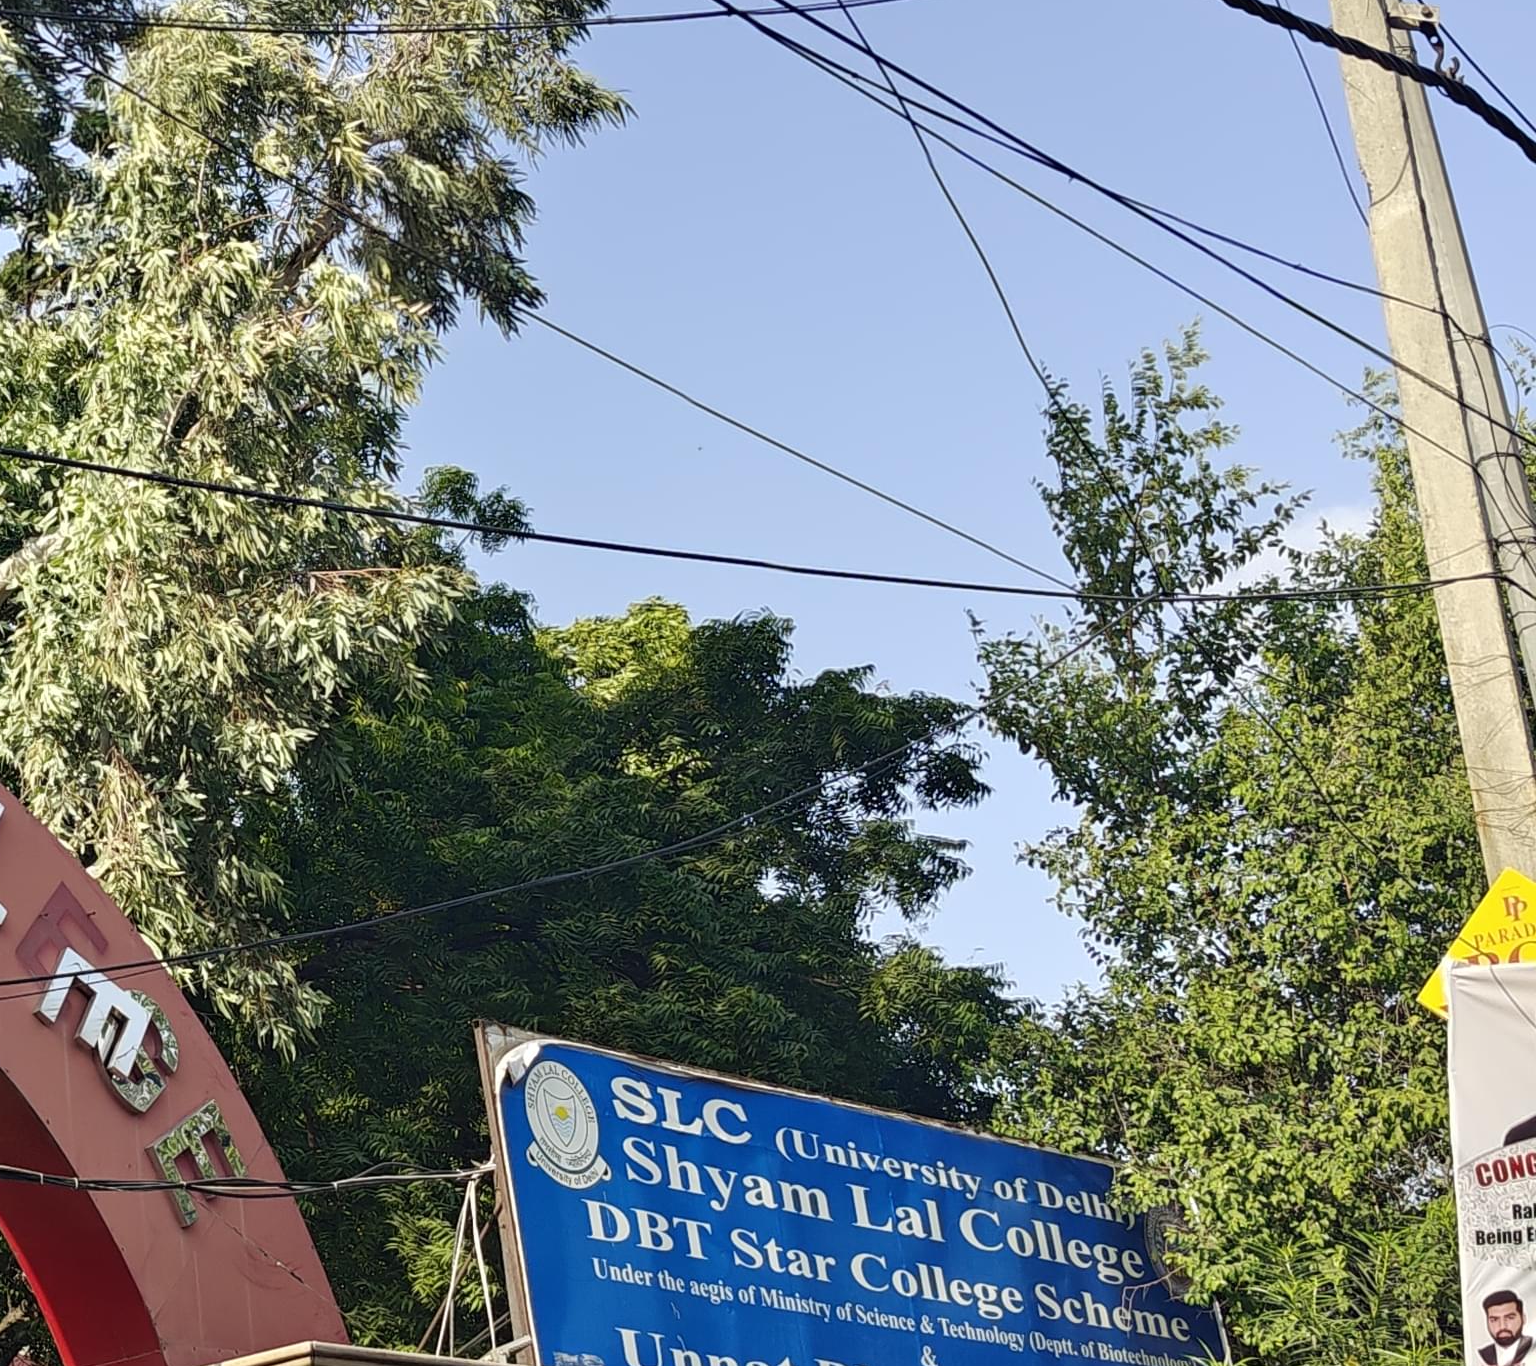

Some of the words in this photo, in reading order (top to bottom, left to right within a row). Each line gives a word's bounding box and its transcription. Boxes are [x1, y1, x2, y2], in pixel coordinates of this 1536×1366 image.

[612, 1076, 752, 1145] SLC
[775, 1126, 982, 1201] (University
[993, 1173, 1030, 1204] of
[582, 1199, 713, 1261] DBT
[734, 1227, 836, 1284] Star
[848, 1253, 1024, 1320] College
[1036, 1284, 1190, 1343] Scheme
[622, 1136, 833, 1221] Shyam
[850, 1184, 944, 1243] Lal
[959, 1207, 1144, 1284] College
[1476, 1229, 1522, 1246] Being
[592, 1257, 653, 1287] Under
[658, 1270, 685, 1293] the
[690, 1277, 733, 1305] aegis
[738, 1283, 756, 1306] of
[761, 1287, 832, 1323] Ministry
[836, 1300, 852, 1323] of
[856, 1304, 915, 1331] Science
[921, 1313, 934, 1334] &
[939, 1315, 1025, 1352] Technology
[1030, 1329, 1076, 1361] (Deptt.
[1080, 1337, 1094, 1359] of
